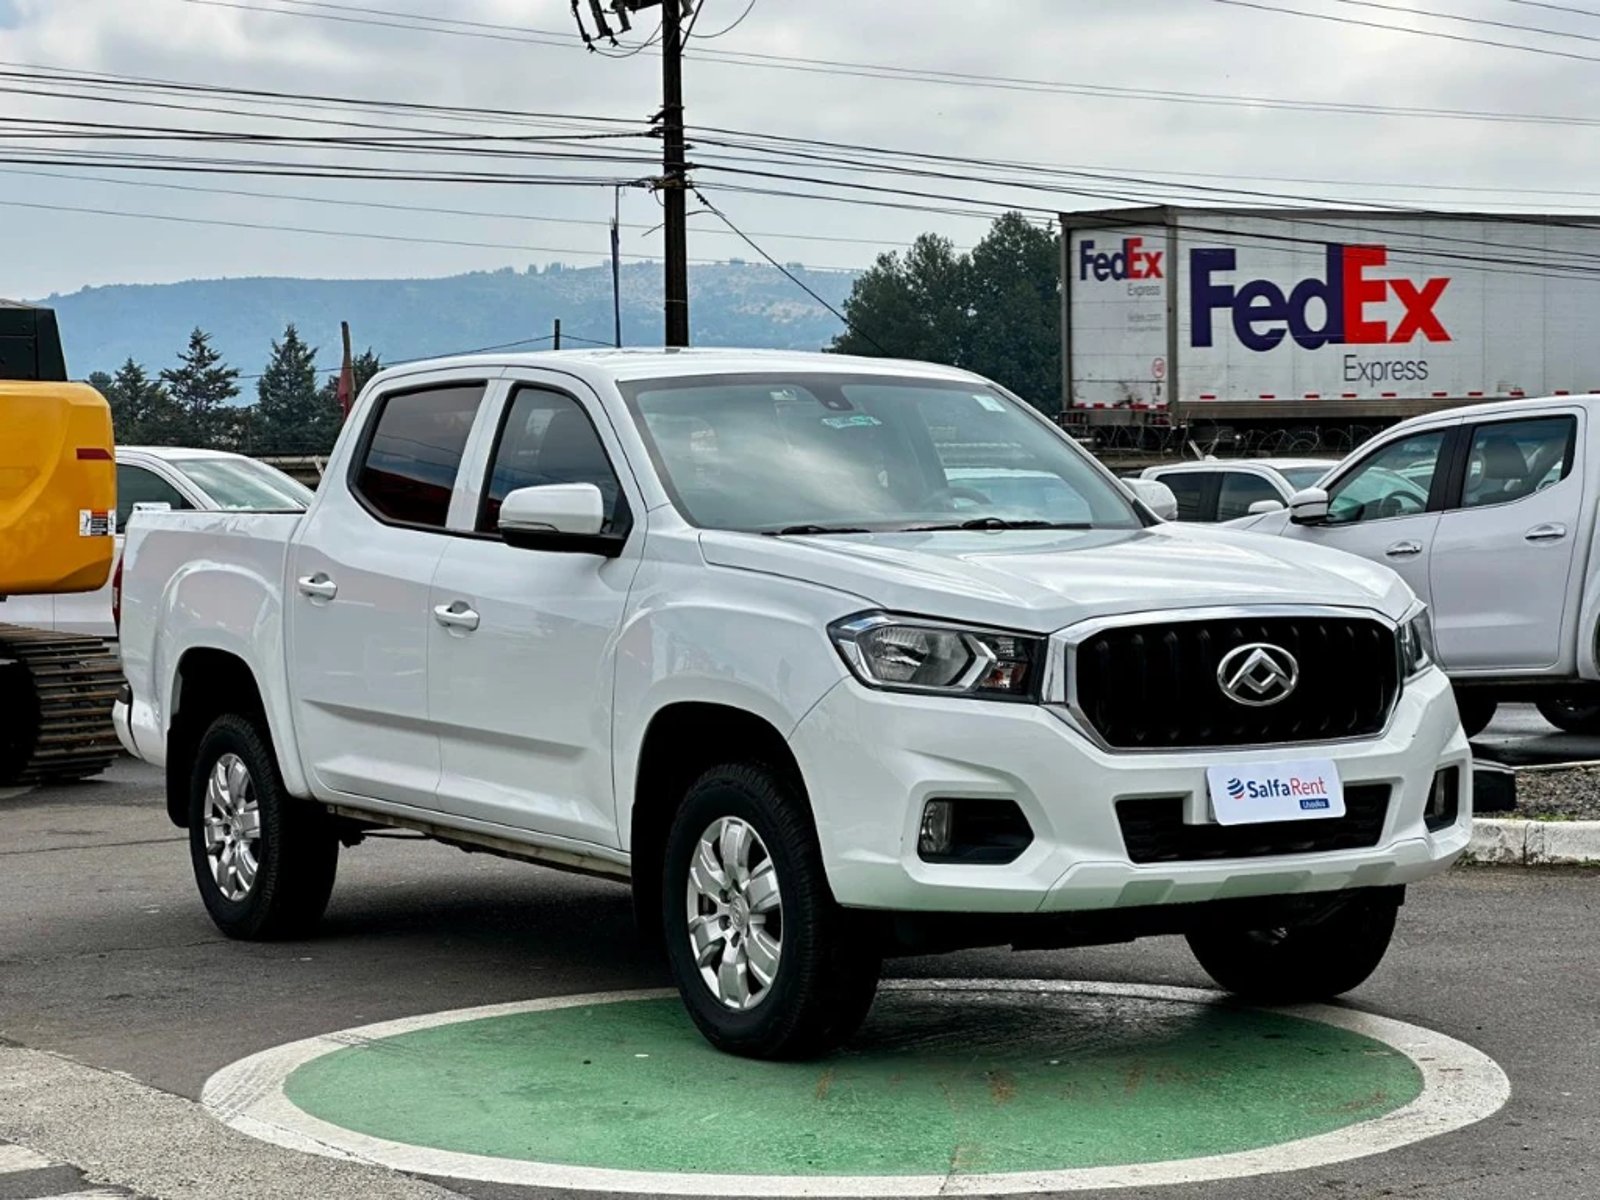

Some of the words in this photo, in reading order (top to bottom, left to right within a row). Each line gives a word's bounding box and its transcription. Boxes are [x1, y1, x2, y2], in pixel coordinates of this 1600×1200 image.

[1080, 237, 1164, 282] FedEx
[1190, 243, 1452, 353] FedEx
[1343, 354, 1429, 387] Express
[1247, 776, 1327, 799] SalfaRent
